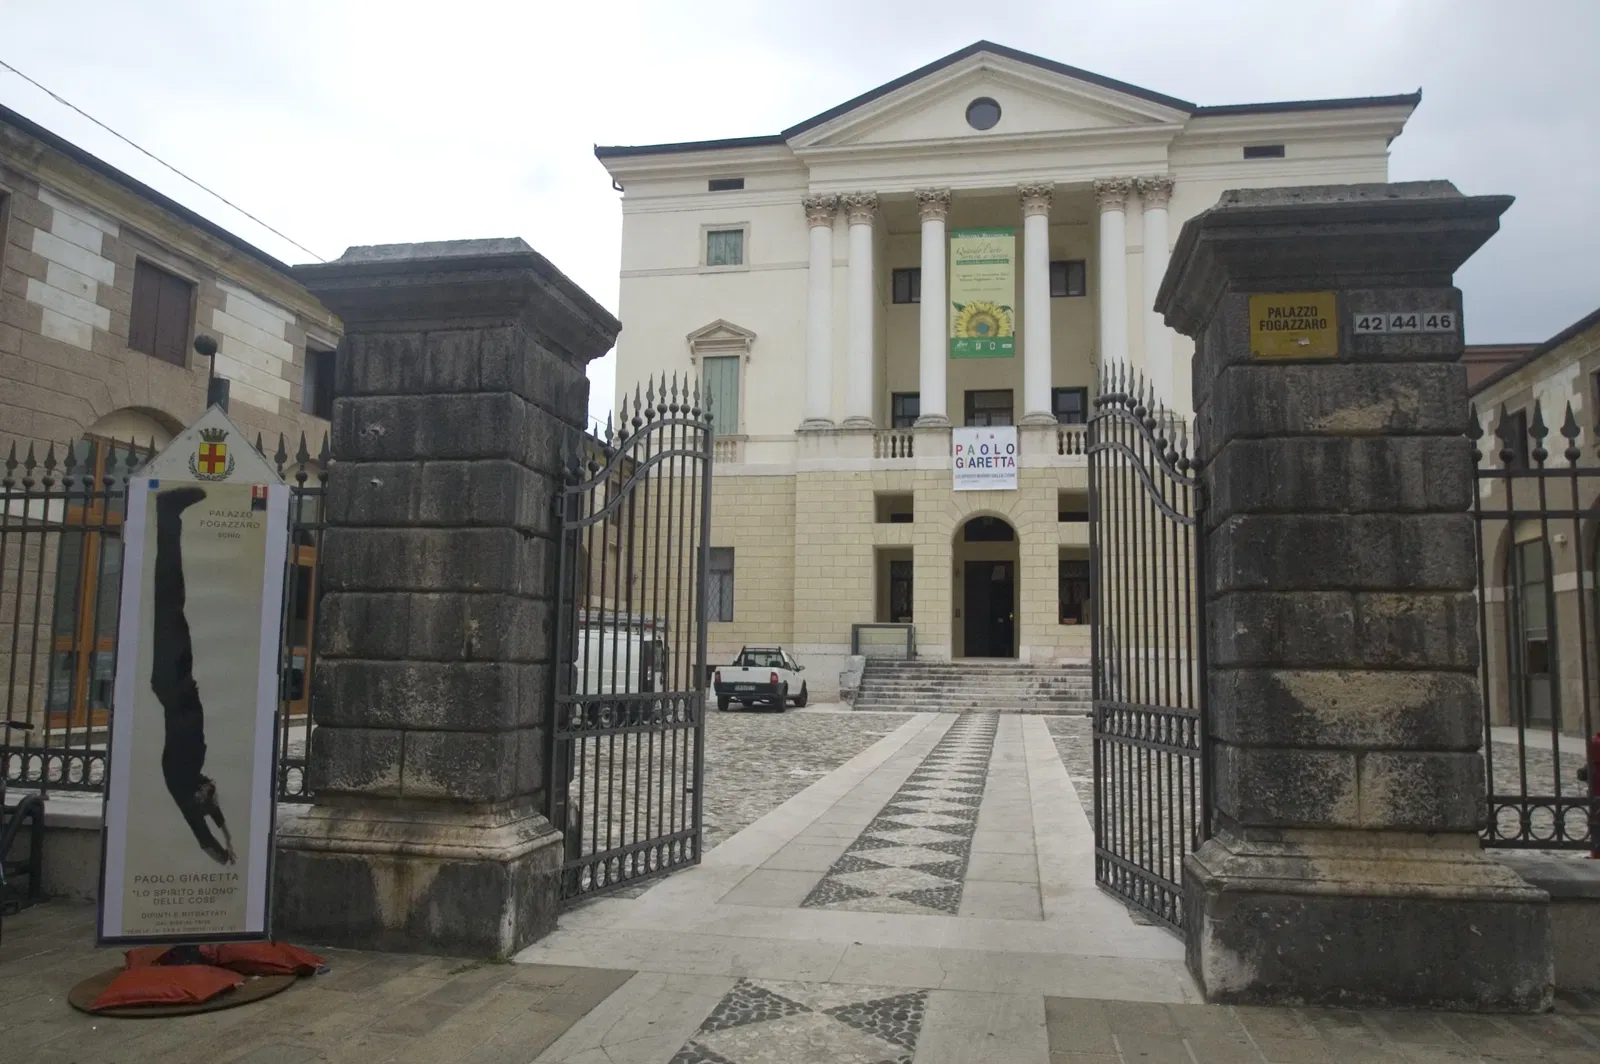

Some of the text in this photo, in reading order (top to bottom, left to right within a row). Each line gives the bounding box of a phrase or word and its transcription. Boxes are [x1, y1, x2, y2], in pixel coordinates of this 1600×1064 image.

[1267, 306, 1318, 318] PALAZZO
[1259, 318, 1328, 331] FOGAZZARO
[1358, 314, 1451, 330] 42 44 46
[955, 443, 1015, 455] PAOLO
[955, 456, 1015, 469] GIARETTA
[209, 510, 253, 519] PALAZZO
[200, 520, 260, 529] FOGAZZARO
[134, 873, 239, 884] PAOLO GIARETTA
[153, 888, 194, 897] SPIRITO
[153, 896, 217, 905] DELLE COSE
